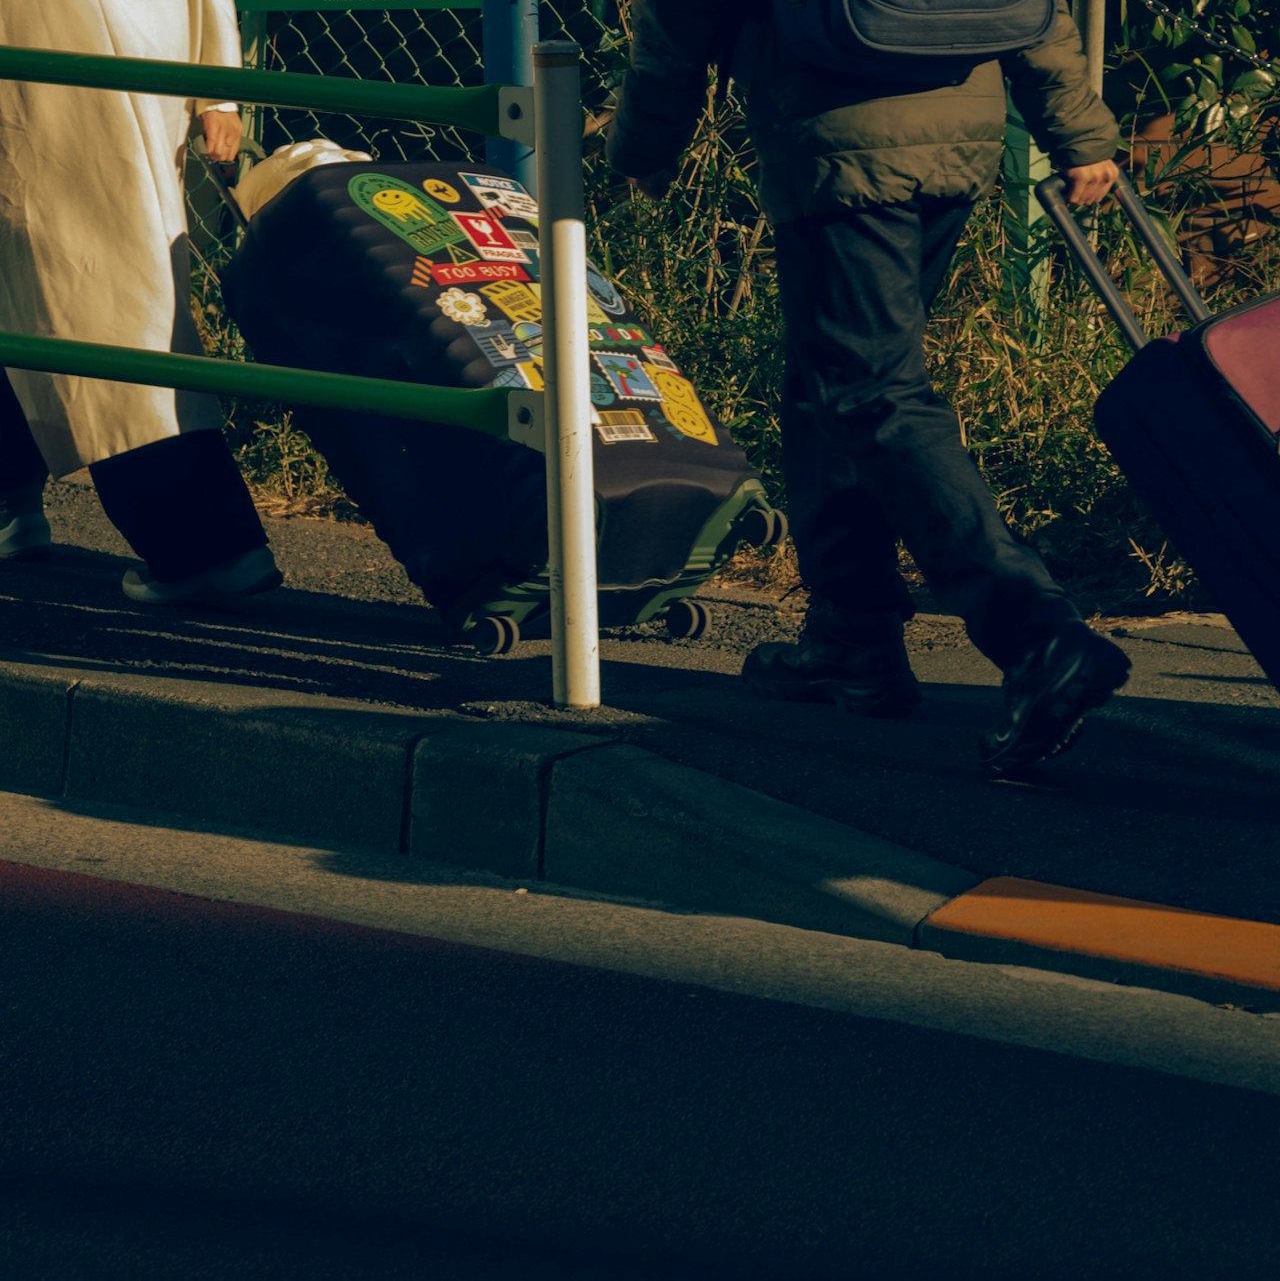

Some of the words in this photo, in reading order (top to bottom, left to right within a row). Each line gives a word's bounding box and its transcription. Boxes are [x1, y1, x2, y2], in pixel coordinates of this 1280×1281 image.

[481, 249, 525, 259] FRAGILE
[438, 267, 476, 280] TOO
[479, 265, 518, 278] BUSY
